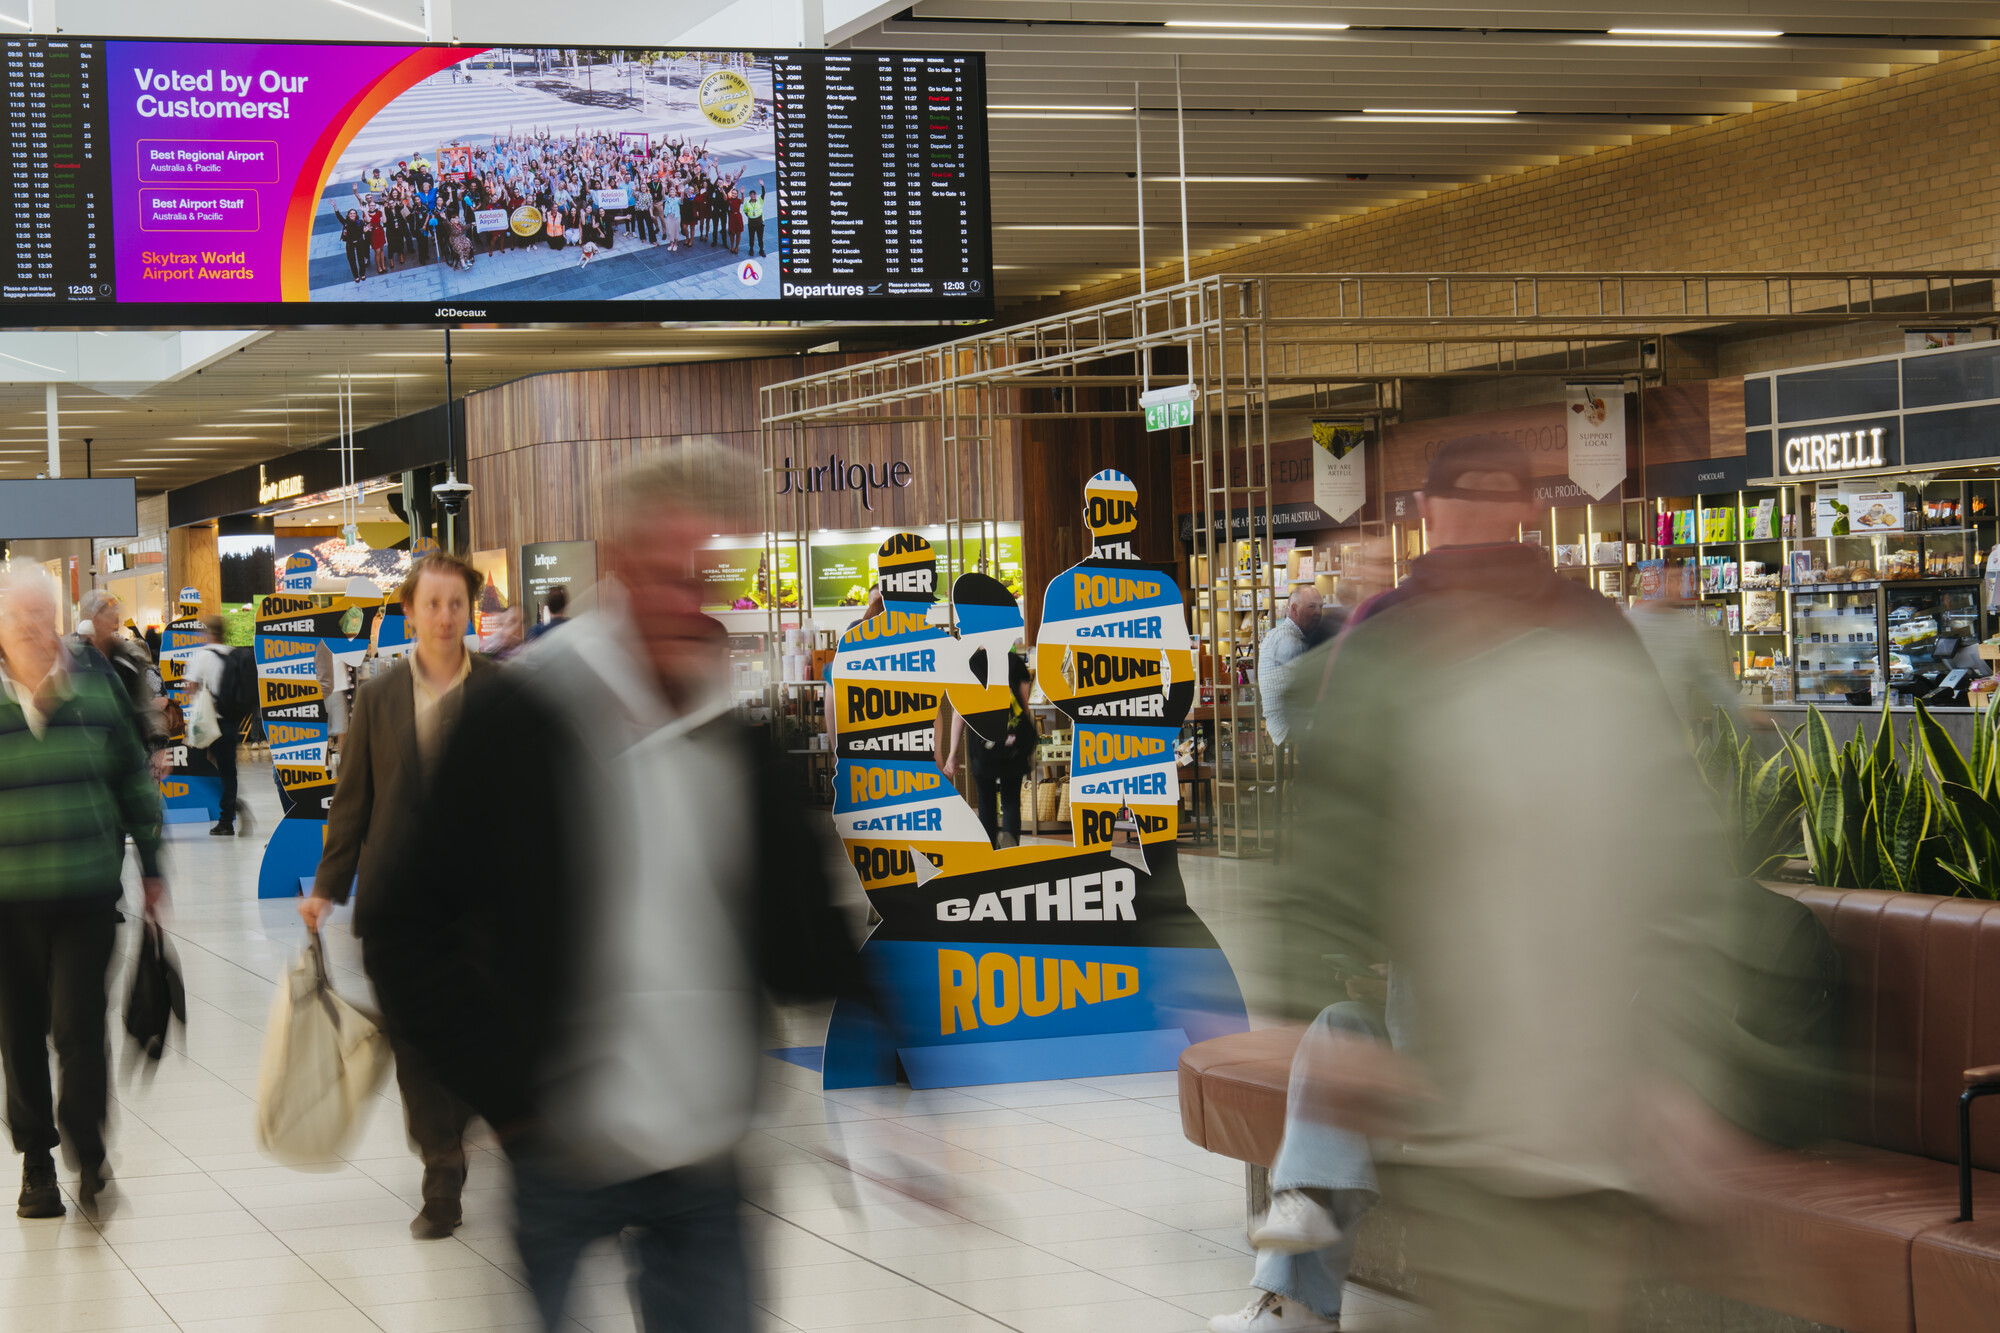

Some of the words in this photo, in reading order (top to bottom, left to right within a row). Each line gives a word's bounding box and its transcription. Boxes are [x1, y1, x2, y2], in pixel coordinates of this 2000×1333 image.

[134, 68, 213, 91] Voted
[221, 70, 252, 97] by
[259, 70, 309, 93] Our
[703, 76, 718, 96] WORLD
[719, 74, 745, 88] AIRPORT
[714, 85, 733, 93] WINNER
[136, 94, 290, 119] Customers!
[703, 90, 748, 106] SKYTRAX
[709, 112, 735, 124] AWARDS
[737, 104, 749, 120] 2026
[150, 150, 175, 160] Best
[177, 150, 224, 162] Regional
[227, 151, 264, 163] Airport
[151, 164, 185, 172] Australia
[187, 164, 193, 172] &
[195, 164, 221, 172] Pacific
[152, 199, 177, 209] Best
[179, 199, 217, 211] Airport
[220, 199, 244, 209] Staff
[152, 212, 187, 221] Australia
[197, 213, 223, 221] Pacific
[479, 212, 504, 220] Adelaide
[479, 218, 499, 226] Airport
[142, 251, 198, 266] Skytrax
[201, 251, 245, 264] World
[143, 267, 194, 282] Airport
[198, 267, 254, 279] Awards
[67, 285, 94, 294] 12:03
[783, 283, 864, 299] Departures
[943, 282, 965, 290] 12:03
[435, 309, 487, 317] JCDecaux
[1580, 432, 1613, 440] SUPPORT
[1785, 427, 1887, 474] CIRELLI
[776, 454, 912, 511] Jurlique
[1216, 466, 1241, 488] TE
[1280, 457, 1311, 483] EDIT
[1698, 472, 1725, 481] CHOCOLATE
[1534, 486, 1553, 500] OCAL
[1555, 484, 1589, 498] PRODUC
[1085, 496, 1138, 528] OUN
[1214, 519, 1224, 530] AKE
[1290, 510, 1321, 523] AUSTRALIA
[1091, 541, 1141, 560] ATH
[1074, 573, 1161, 611] ROUND
[263, 597, 314, 617] ROUND
[263, 619, 315, 632] GATHER
[1076, 615, 1162, 639] GATHER
[264, 638, 316, 660] ROUND
[266, 662, 317, 675] GATHER
[846, 649, 936, 672] GATHER
[1077, 651, 1161, 689] ROUND
[267, 682, 318, 702] ROUND
[267, 704, 319, 718] GATHER
[847, 685, 937, 724] ROUND
[1078, 693, 1165, 717] GATHER
[268, 725, 320, 745] ROUND
[849, 727, 935, 751] GATHER
[1079, 730, 1165, 768] ROUND
[850, 765, 940, 803] ROUND
[1081, 771, 1167, 795] GATHER
[852, 807, 942, 831] GATHER
[1082, 809, 1168, 846] ROND
[936, 867, 1137, 922] GATHER
[938, 948, 1139, 1036] ROUND
